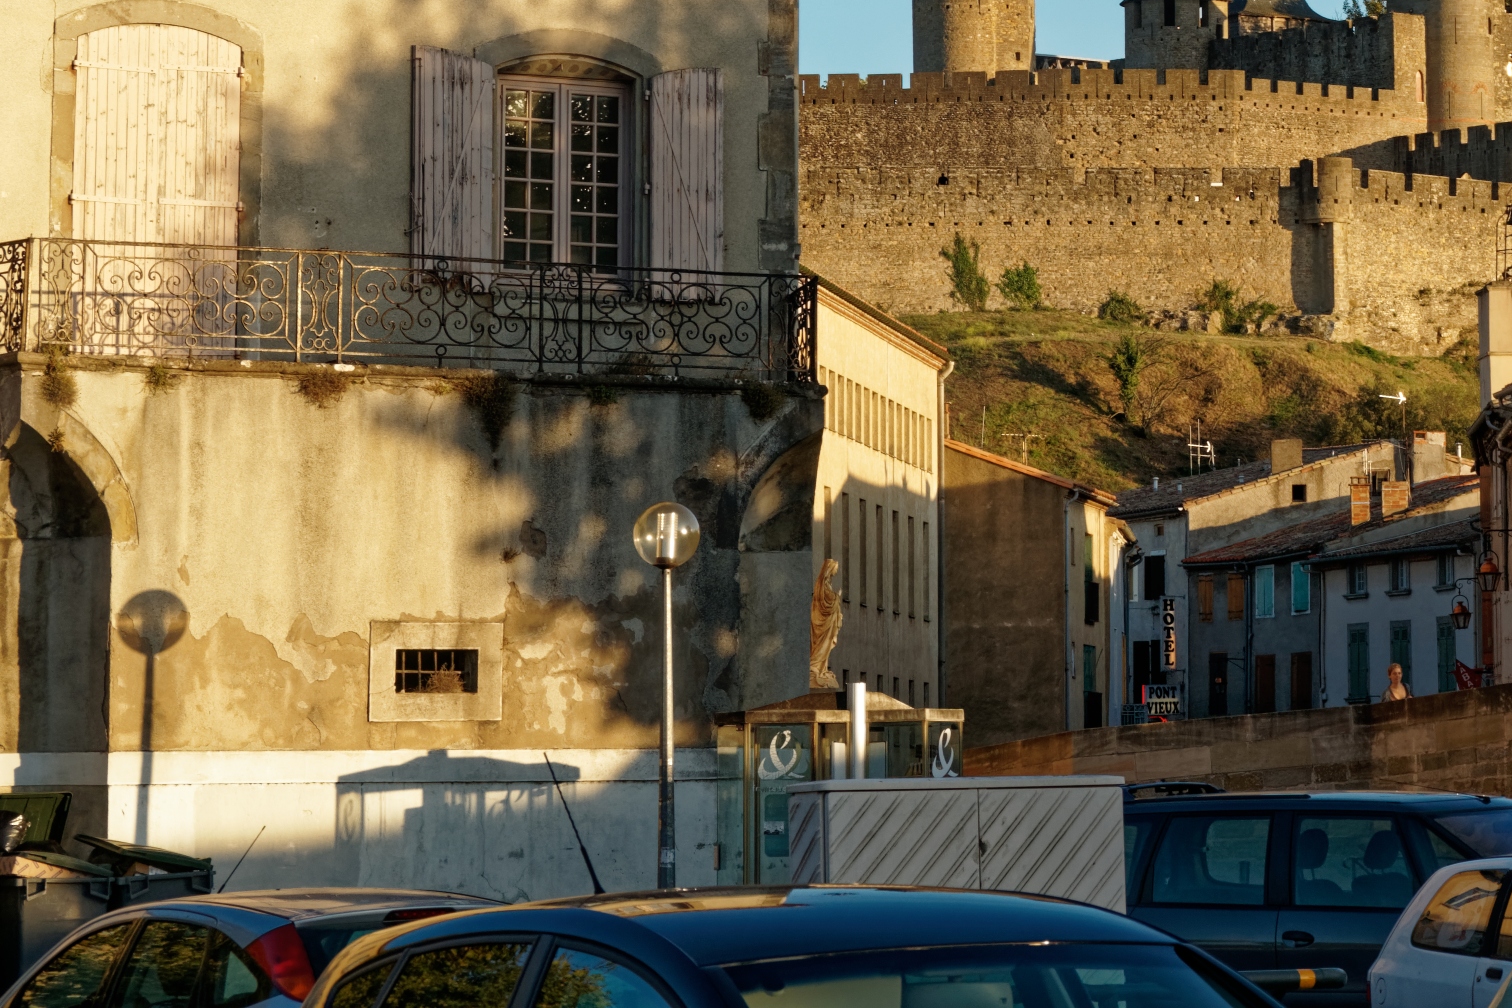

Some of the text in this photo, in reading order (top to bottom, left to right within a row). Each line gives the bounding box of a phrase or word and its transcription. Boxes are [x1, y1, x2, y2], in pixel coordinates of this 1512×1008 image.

[1162, 598, 1175, 666] HOTEL
[1148, 686, 1178, 699] PONT
[1146, 701, 1181, 714] VIEUX
